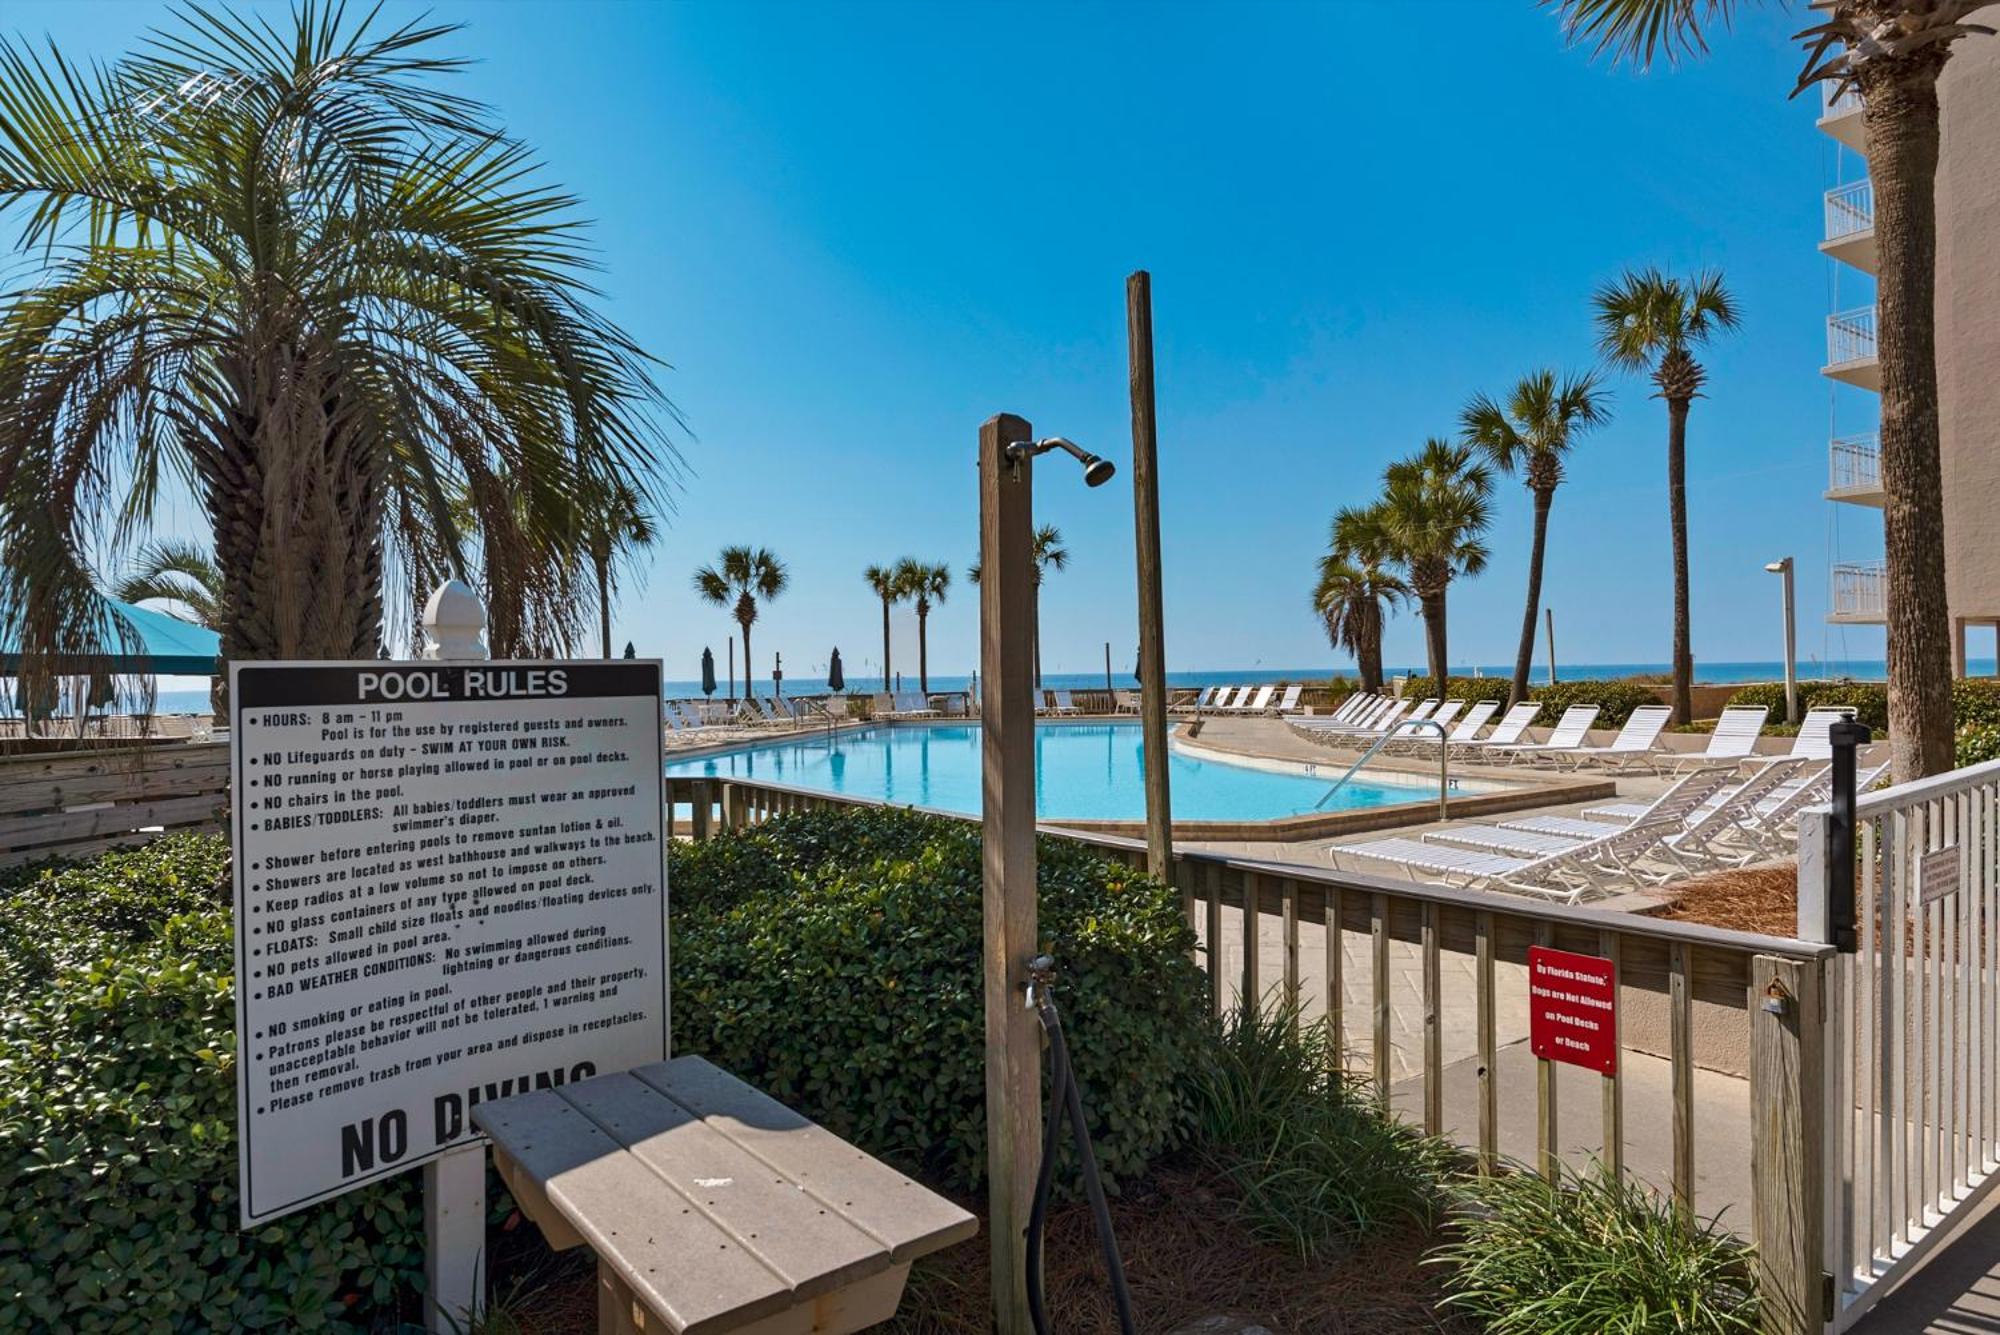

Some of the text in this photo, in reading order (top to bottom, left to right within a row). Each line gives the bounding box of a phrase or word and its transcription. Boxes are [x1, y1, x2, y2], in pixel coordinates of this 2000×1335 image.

[358, 669, 568, 700] POOL RULES
[262, 710, 402, 727] HOURS: 8 am 11 pm
[321, 717, 627, 741] Pool is for the use by registered guests and owners.
[263, 735, 570, 766] NO Lifeguards on duty SWIM AT YOUR OWN RISK.
[263, 750, 629, 787] NO running or horse playing allowed pool pool decks.
[263, 784, 403, 810] NO chairs in the pool.
[392, 803, 408, 817] All
[508, 792, 535, 806] must
[540, 792, 567, 803] wear
[588, 784, 635, 800] approved
[392, 812, 499, 833] swimmer's diaper.
[264, 820, 591, 870] Shower before entering pools to remove suntan lotion
[265, 831, 655, 891] Showers are located as west bathhouse and walkways beach.
[265, 855, 606, 913] Keep radios at low volume so not to impose others.
[266, 872, 594, 934] NO glass containers any type allowed on pool deck.
[265, 887, 627, 956] FLOATS: Small child size floats and devices
[266, 931, 451, 978] NO pets allowed pool area.
[267, 925, 606, 999] BAD WEATHER CONDITIONS: No swimming allowed during
[442, 935, 632, 976] lightning dangerous conditions.
[268, 983, 452, 1038] NO smoking or eating pool.
[268, 975, 596, 1059] Patrons please be respectful other people and their
[1551, 990, 1565, 1000] are
[1579, 995, 1612, 1010] Allowed
[268, 984, 617, 1076] unacceptable behavior will not be warning and
[1556, 1013, 1573, 1025] Pool
[1574, 1017, 1600, 1031] Decks
[269, 1011, 646, 1113] Please remove trash from your area and dispose receptacles.
[1565, 1037, 1590, 1052] Beach
[269, 1059, 359, 1093] then removal.
[341, 1109, 408, 1178] NO
